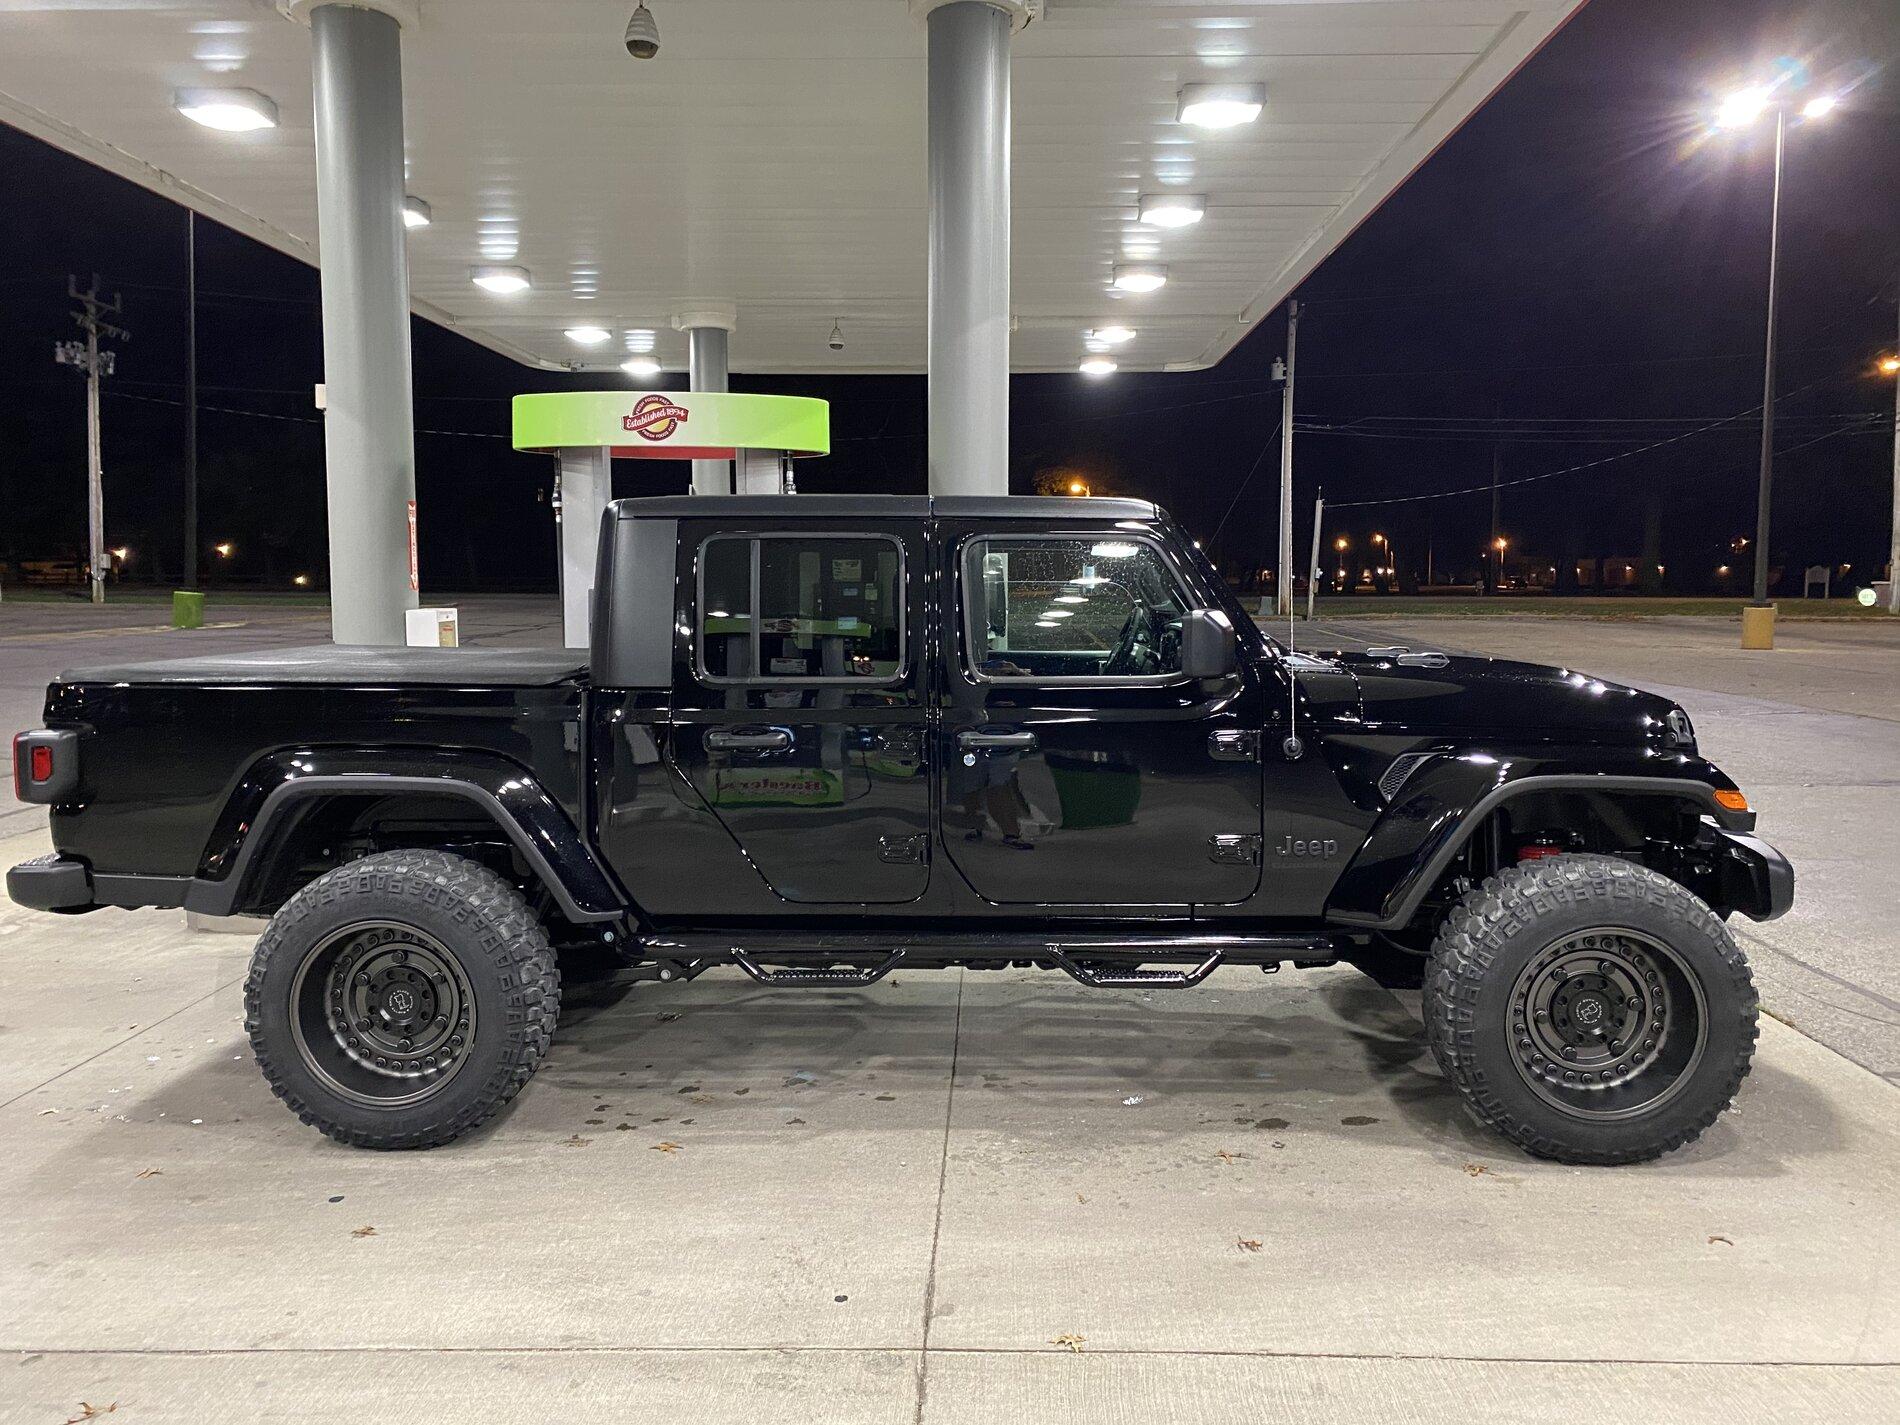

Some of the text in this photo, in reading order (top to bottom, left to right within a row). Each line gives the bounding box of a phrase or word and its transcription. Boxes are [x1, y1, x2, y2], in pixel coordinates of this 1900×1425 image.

[626, 408, 685, 428] Established 1894
[1275, 835, 1338, 860] Jeep
